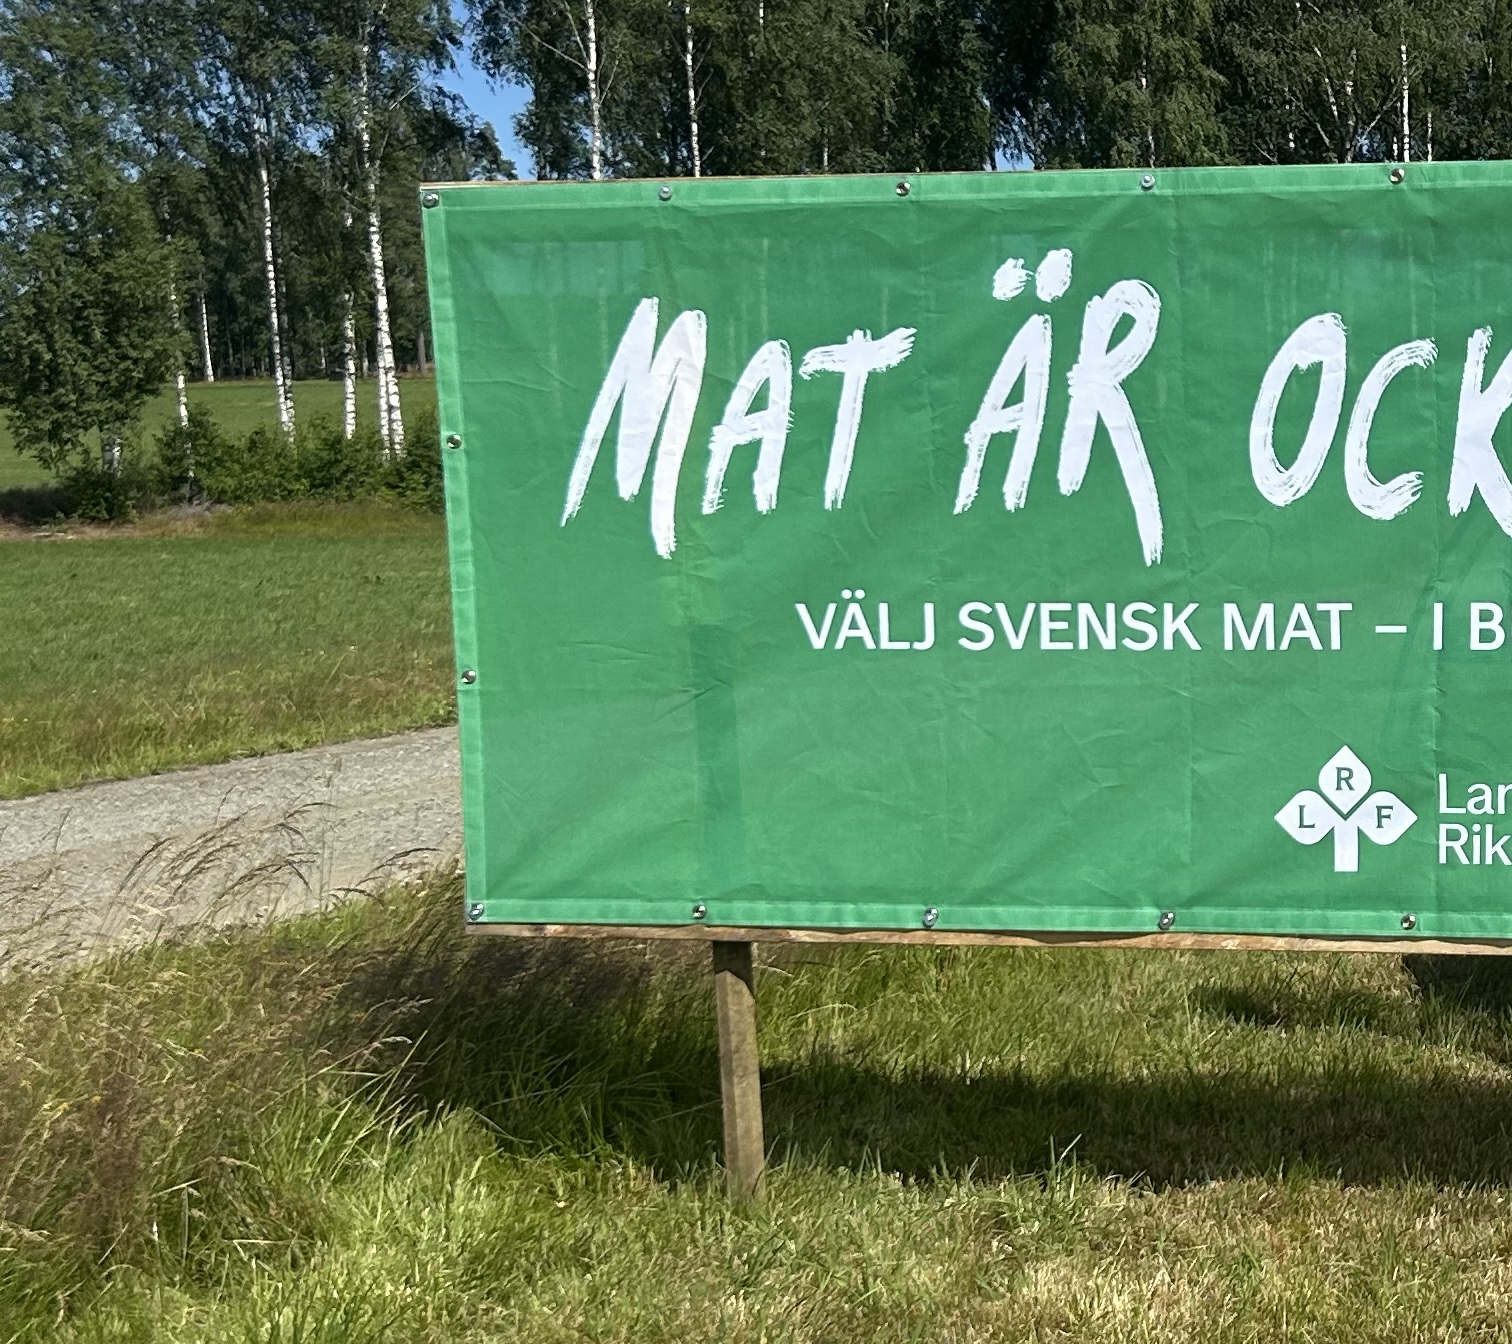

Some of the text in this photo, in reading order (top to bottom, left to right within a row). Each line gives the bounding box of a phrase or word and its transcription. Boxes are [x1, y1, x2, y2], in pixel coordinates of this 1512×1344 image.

[559, 294, 918, 561] MAT
[952, 247, 1165, 568] ÄR
[794, 589, 935, 652] VÄLJ
[957, 600, 1203, 654] SVENSK
[1222, 601, 1353, 653] MAT
[1431, 600, 1444, 652] I
